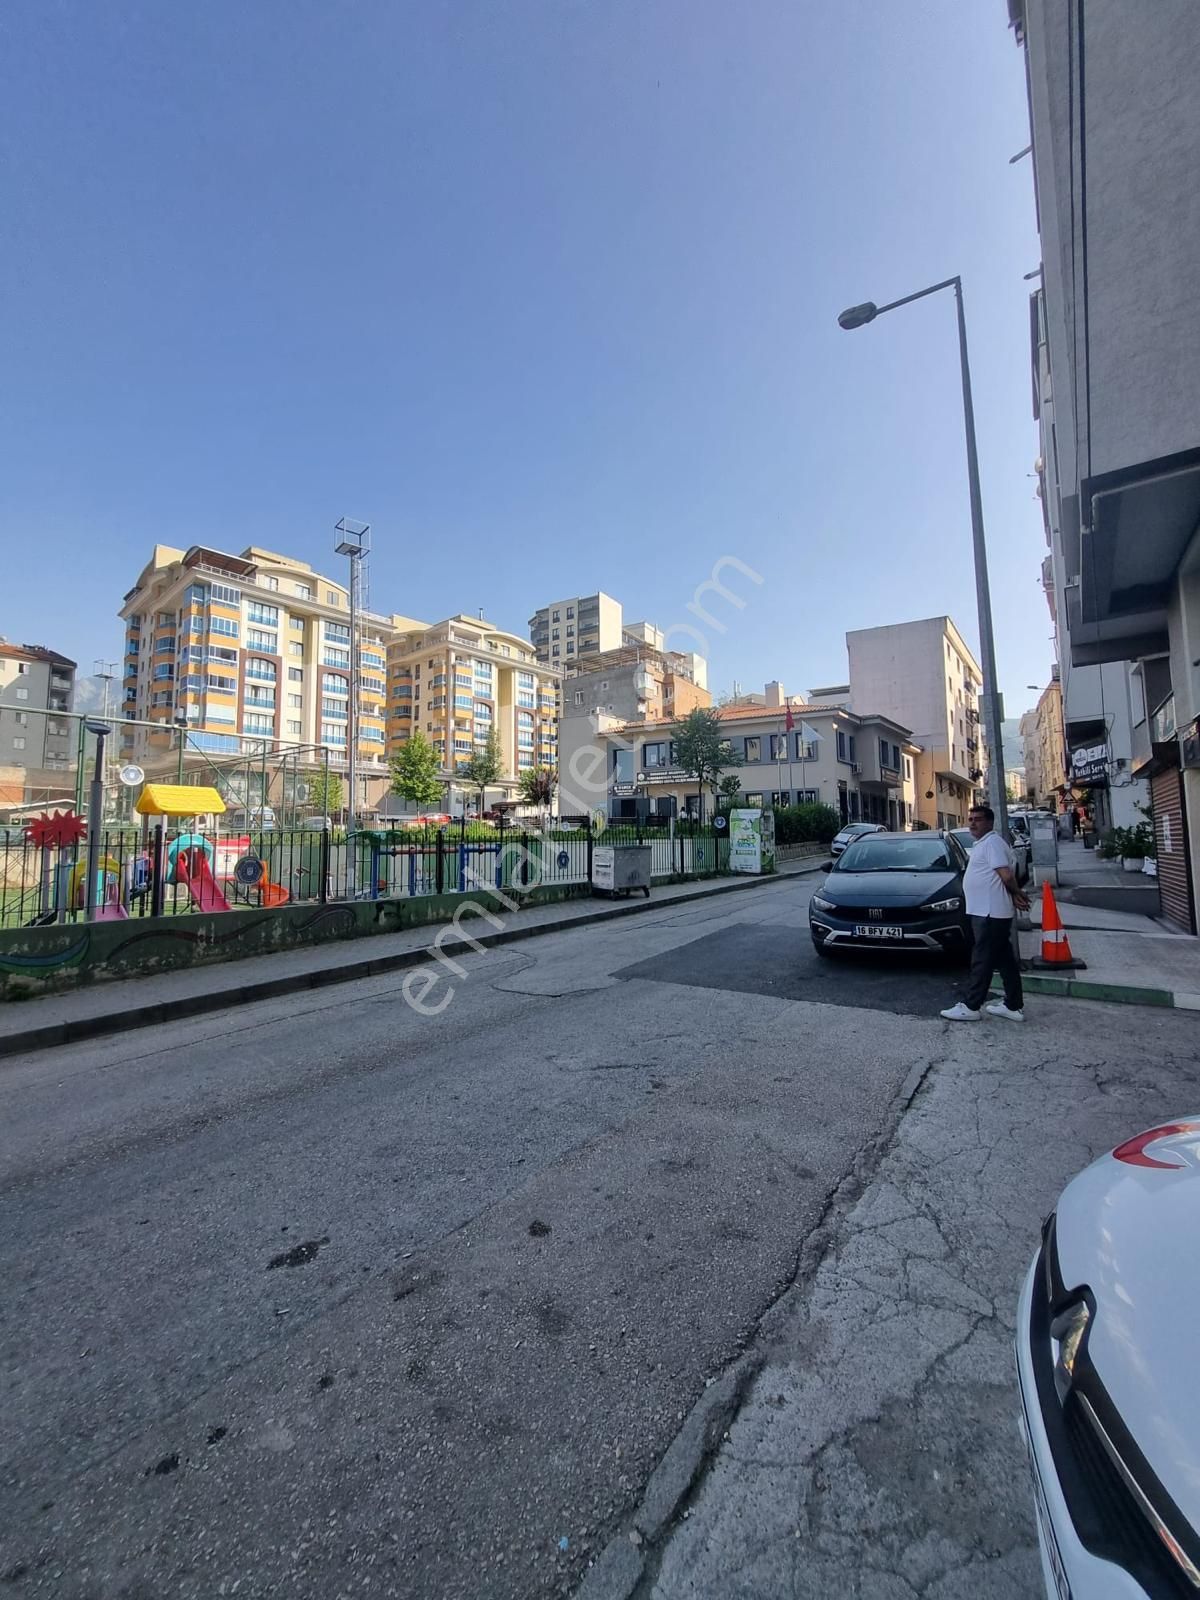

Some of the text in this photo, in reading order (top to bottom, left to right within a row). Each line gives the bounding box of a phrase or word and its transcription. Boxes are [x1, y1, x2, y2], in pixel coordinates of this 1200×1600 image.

[868, 908, 883, 920] FIAT
[857, 926, 901, 936] 16 BFV 421
